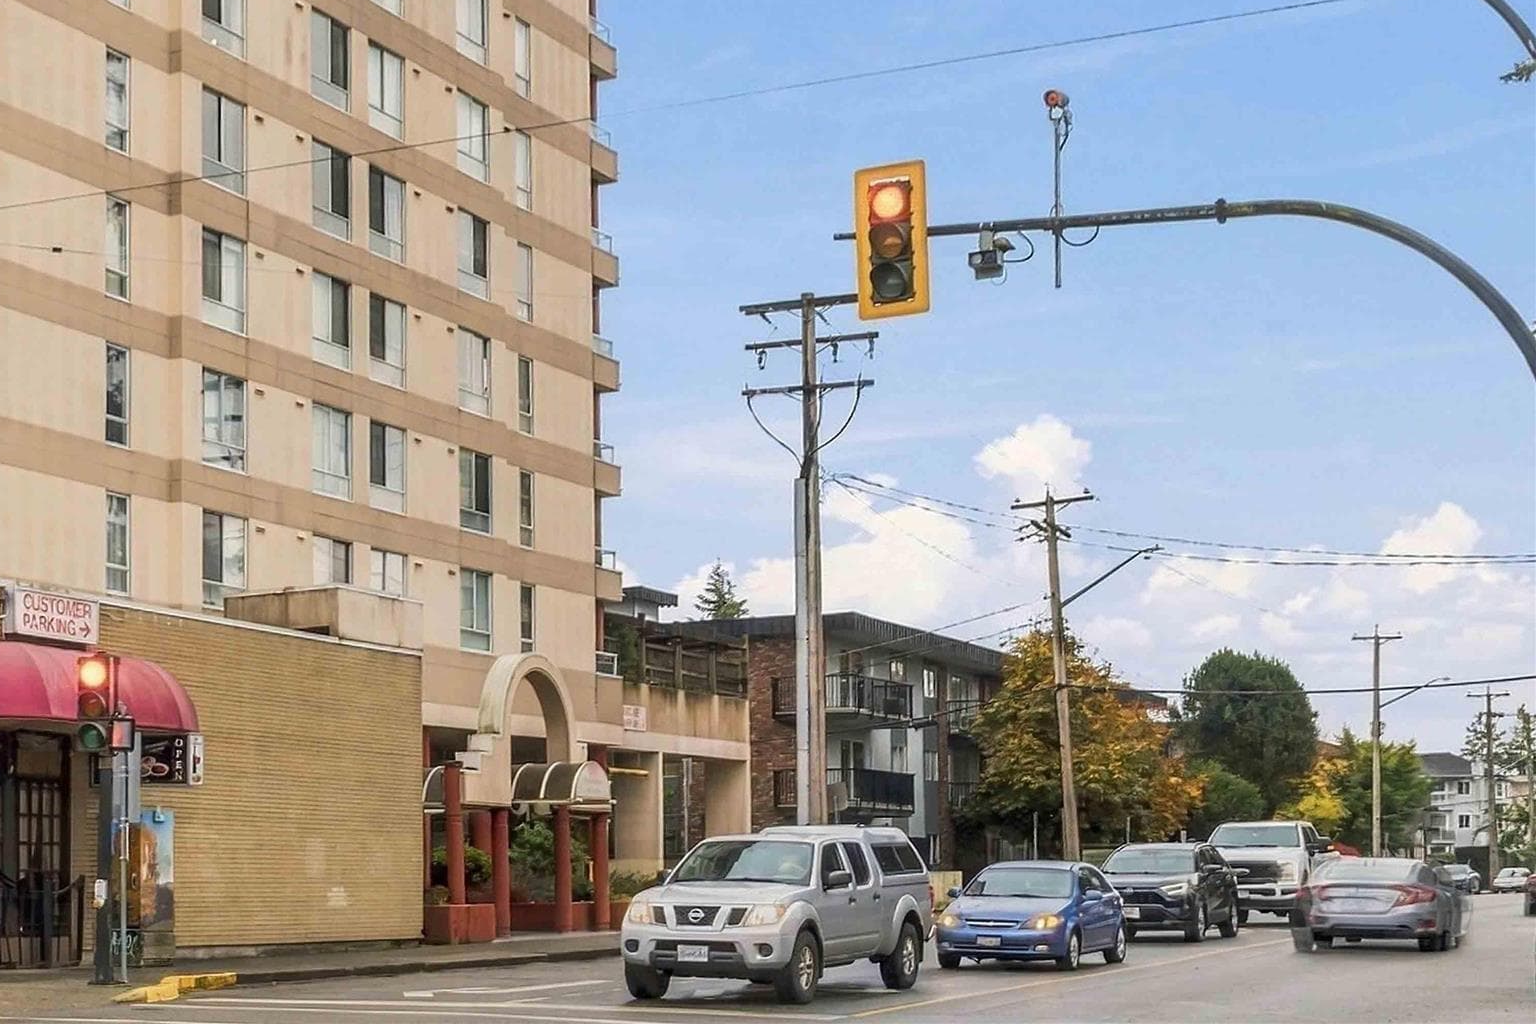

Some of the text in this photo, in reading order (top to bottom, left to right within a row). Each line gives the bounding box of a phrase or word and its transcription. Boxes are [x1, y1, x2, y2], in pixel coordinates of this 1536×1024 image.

[23, 593, 91, 619] CUSTOMER
[23, 613, 76, 636] PARKING
[174, 738, 184, 781] OPEN
